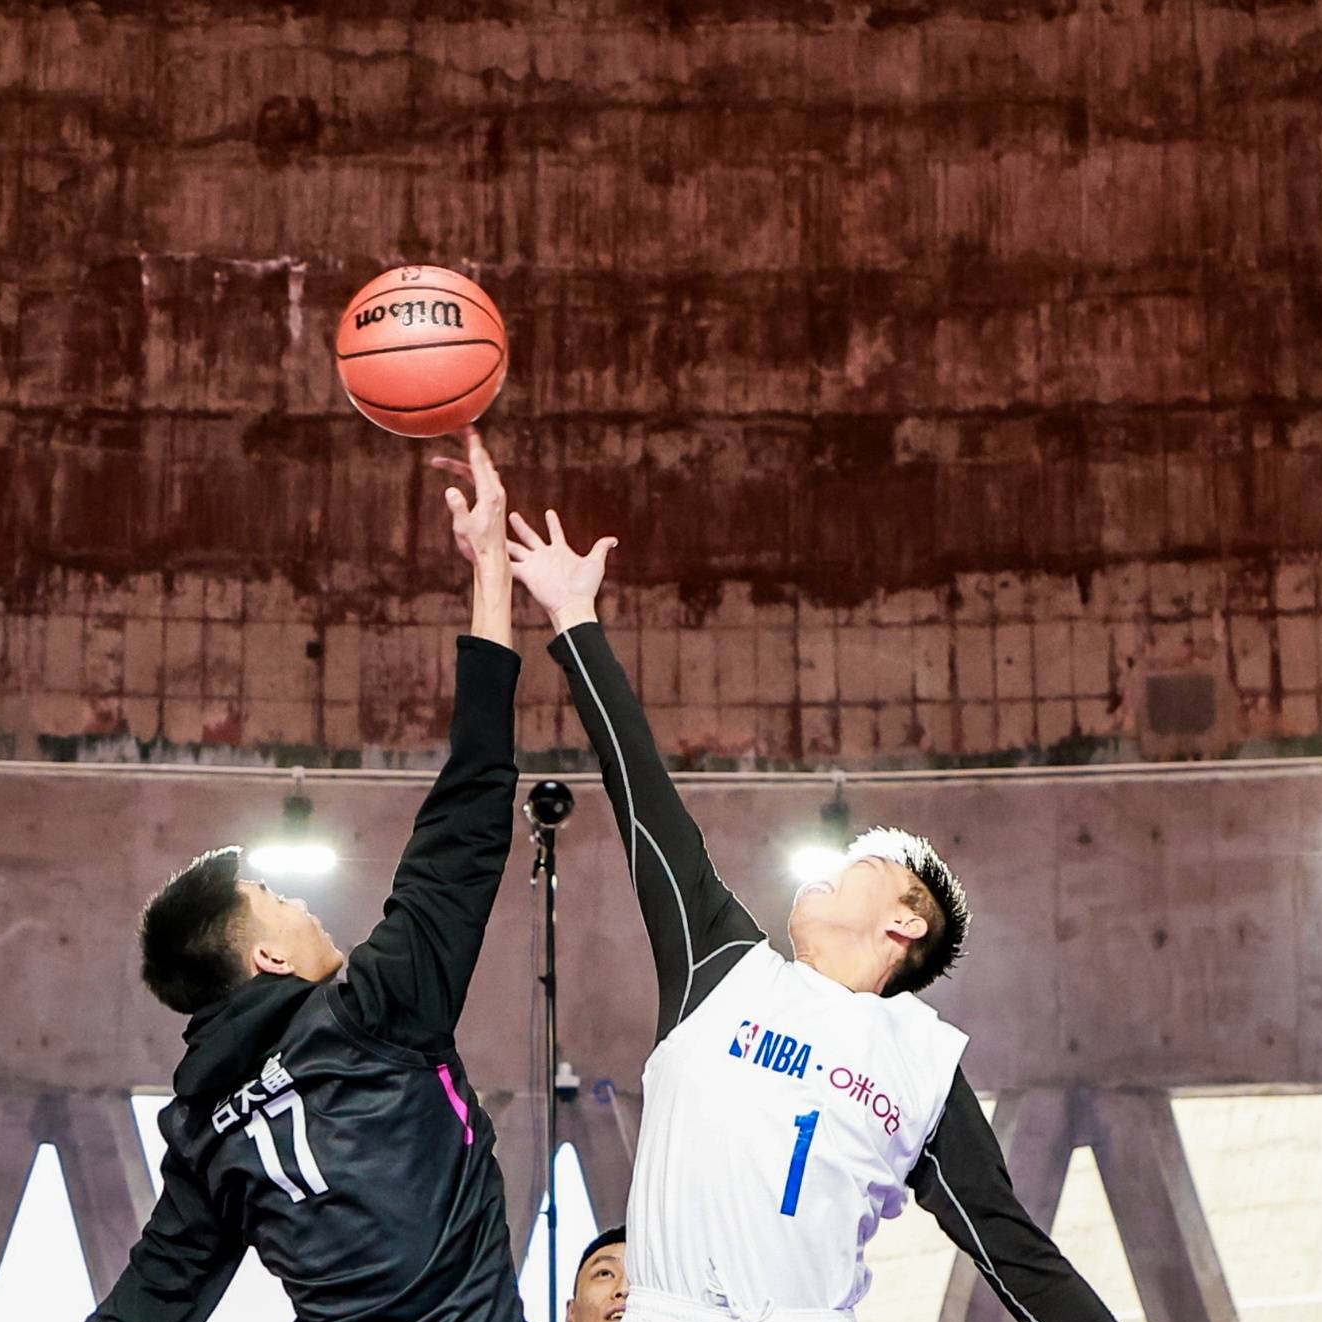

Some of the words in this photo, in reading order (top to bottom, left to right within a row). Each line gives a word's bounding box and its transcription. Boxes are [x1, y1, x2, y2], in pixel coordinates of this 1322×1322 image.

[354, 300, 465, 331] Wilson
[753, 1029, 813, 1080] NBA
[242, 1088, 330, 1204] 17
[779, 1109, 821, 1218] 1
